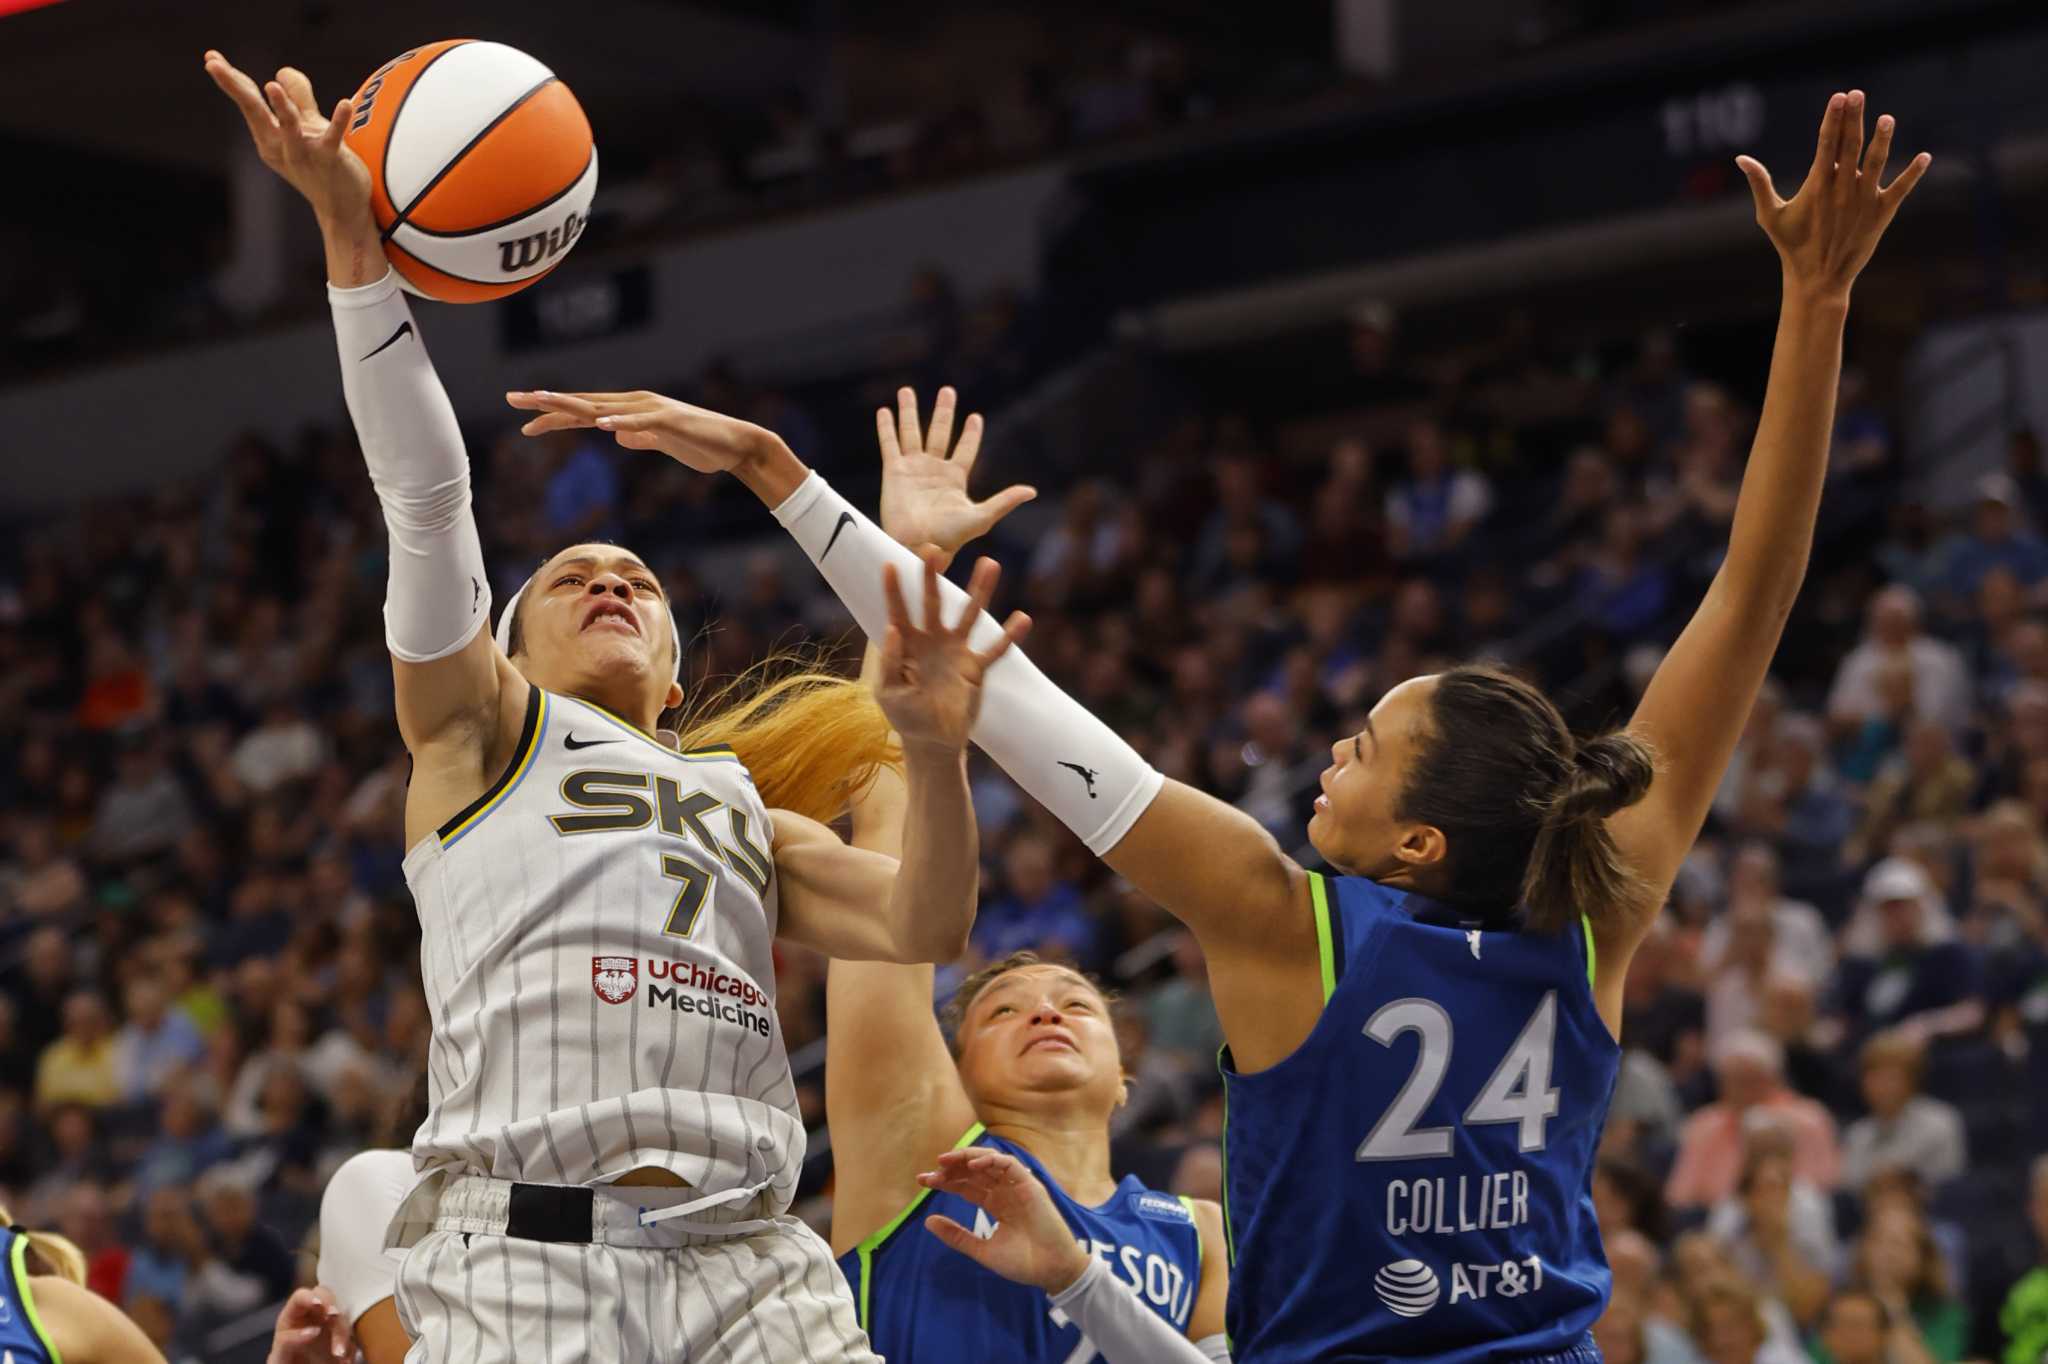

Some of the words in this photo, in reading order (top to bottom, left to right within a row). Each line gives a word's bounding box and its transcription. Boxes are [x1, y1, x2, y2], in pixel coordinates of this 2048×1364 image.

[498, 210, 587, 273] Wils
[546, 768, 772, 902] SKY
[659, 851, 713, 939] 7
[648, 959, 769, 1008] UChicago
[648, 984, 770, 1037] Medicine
[1355, 989, 1561, 1162] 24
[1386, 1170, 1529, 1236] COLLIER
[1448, 1255, 1543, 1304] AT&T
